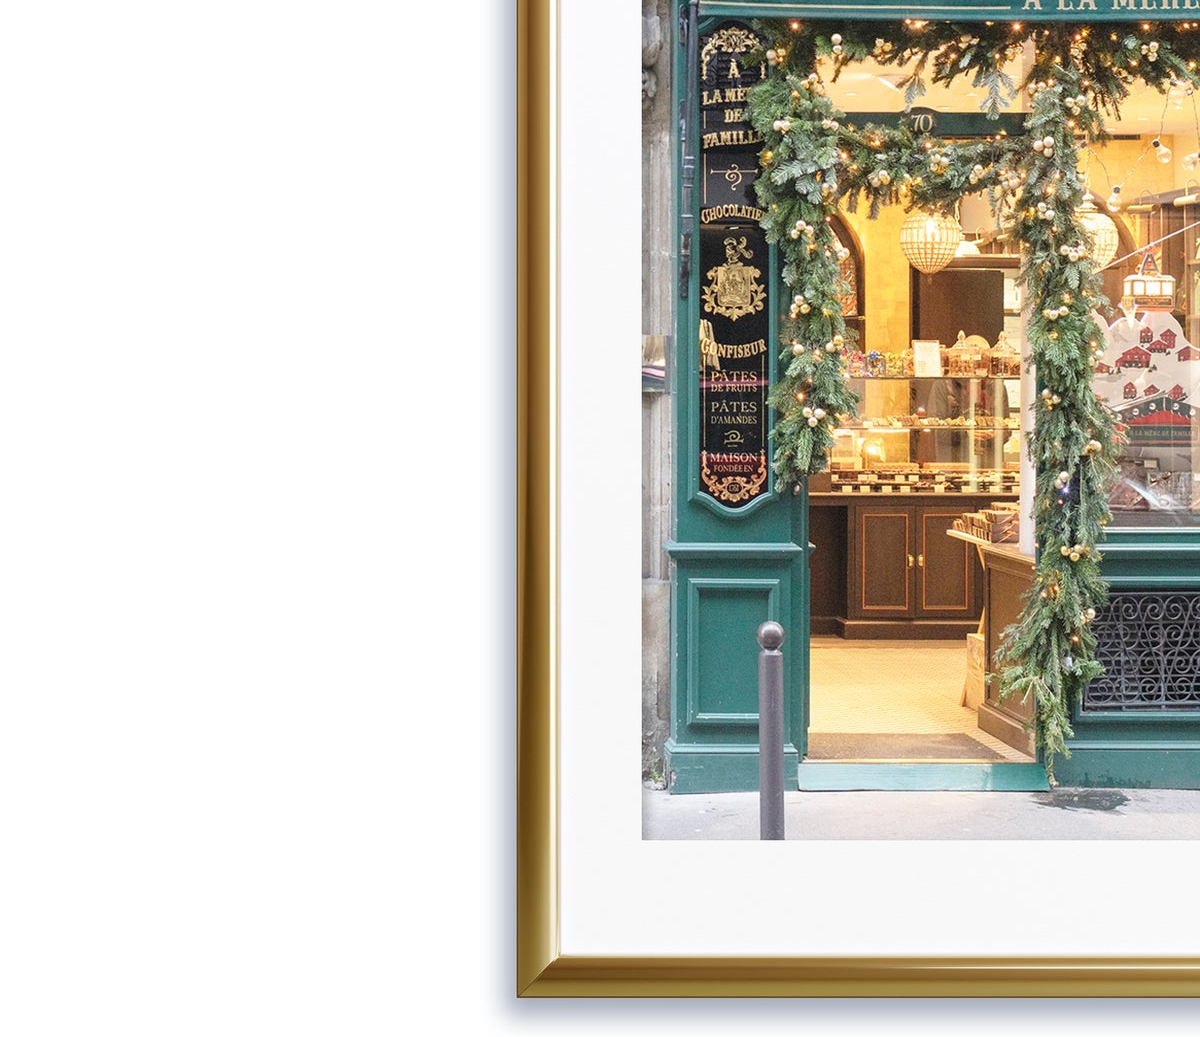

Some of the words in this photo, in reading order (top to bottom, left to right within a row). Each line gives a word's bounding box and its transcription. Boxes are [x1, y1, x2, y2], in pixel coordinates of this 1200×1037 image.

[728, 58, 740, 79] À
[702, 89, 722, 106] LA
[724, 108, 743, 123] DE
[911, 114, 933, 132] 70
[701, 337, 767, 359] CONFISEUR
[711, 369, 757, 382] PÂTES
[711, 384, 724, 392] DE
[726, 384, 757, 392] FRUITS
[711, 400, 757, 413] PÂTES
[711, 415, 757, 424] D'AMANDES
[710, 452, 757, 462] MAISON
